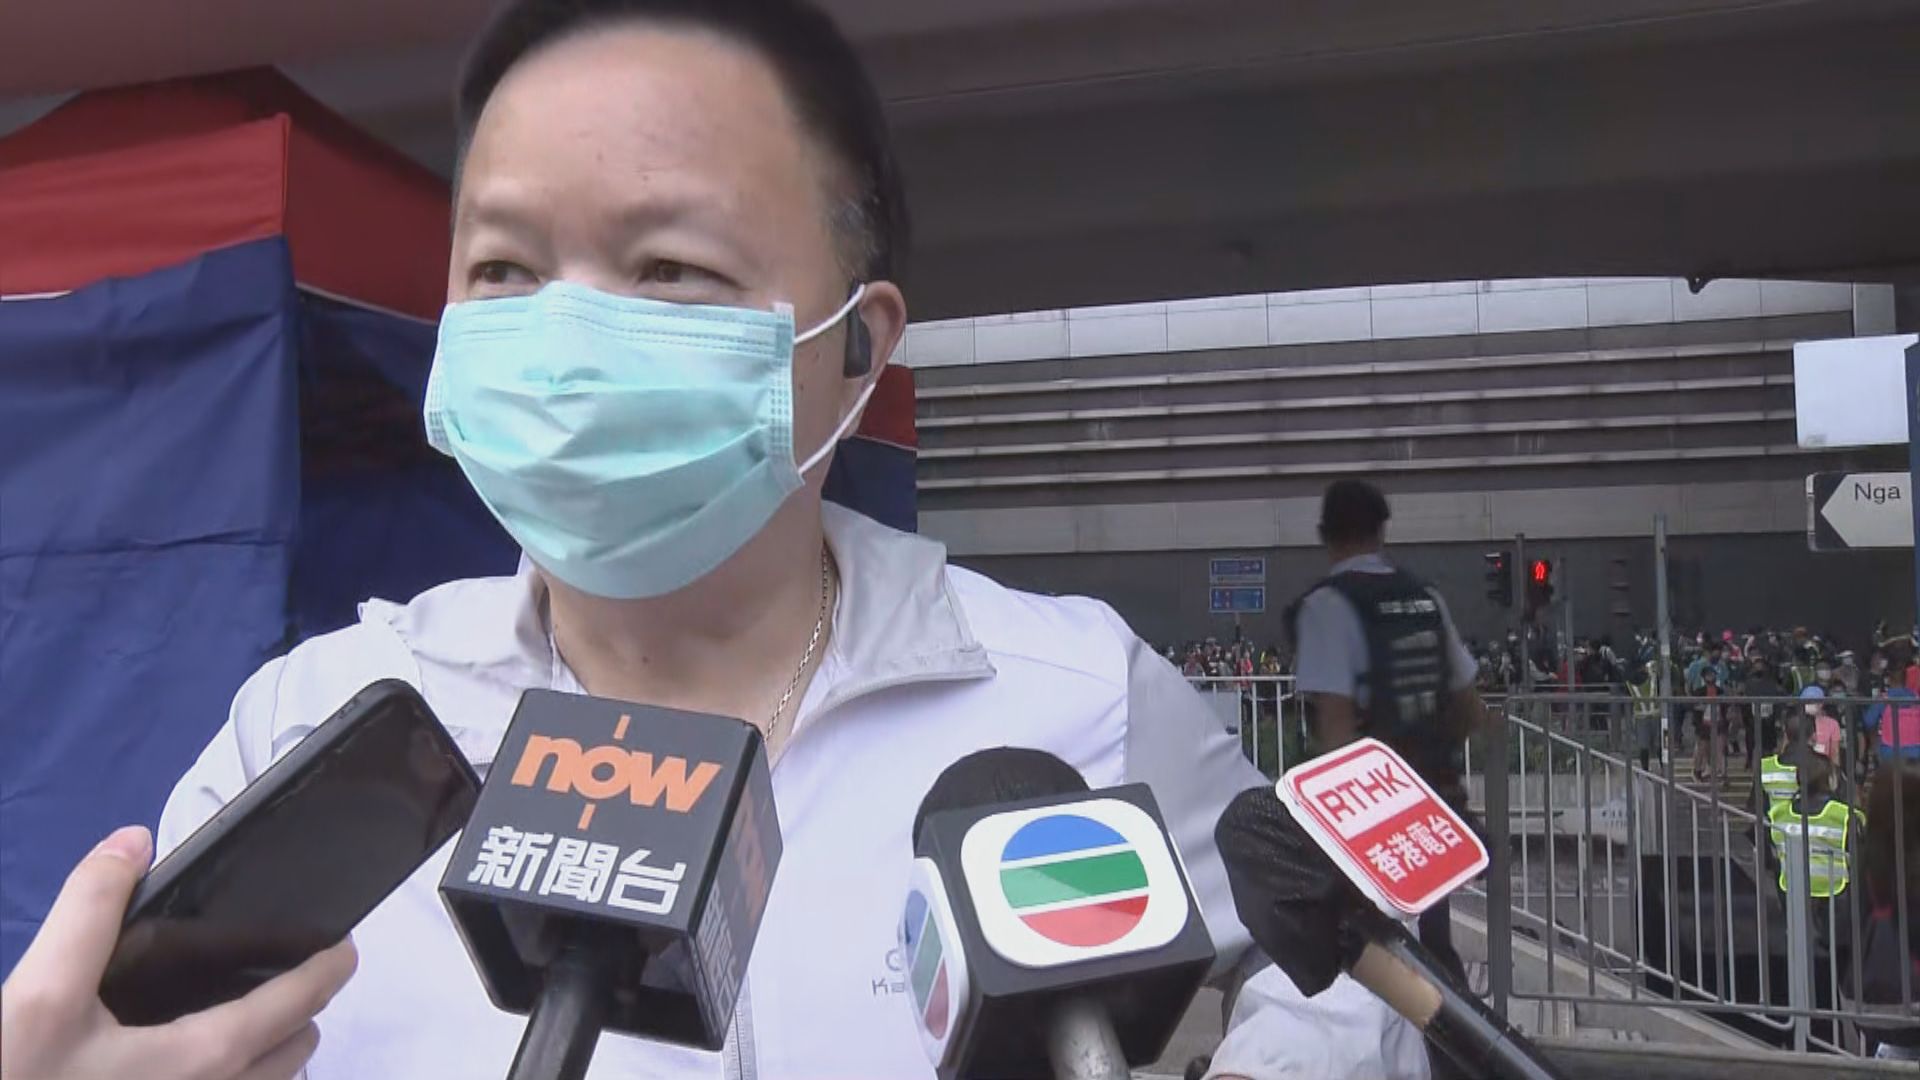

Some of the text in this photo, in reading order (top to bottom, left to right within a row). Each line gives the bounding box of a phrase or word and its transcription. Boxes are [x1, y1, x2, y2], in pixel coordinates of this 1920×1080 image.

[1854, 482, 1901, 504] Nga
[511, 734, 723, 813] now
[1315, 762, 1410, 823] RTHK
[467, 825, 687, 915] 新聞台
[1365, 814, 1462, 883] 香港電台
